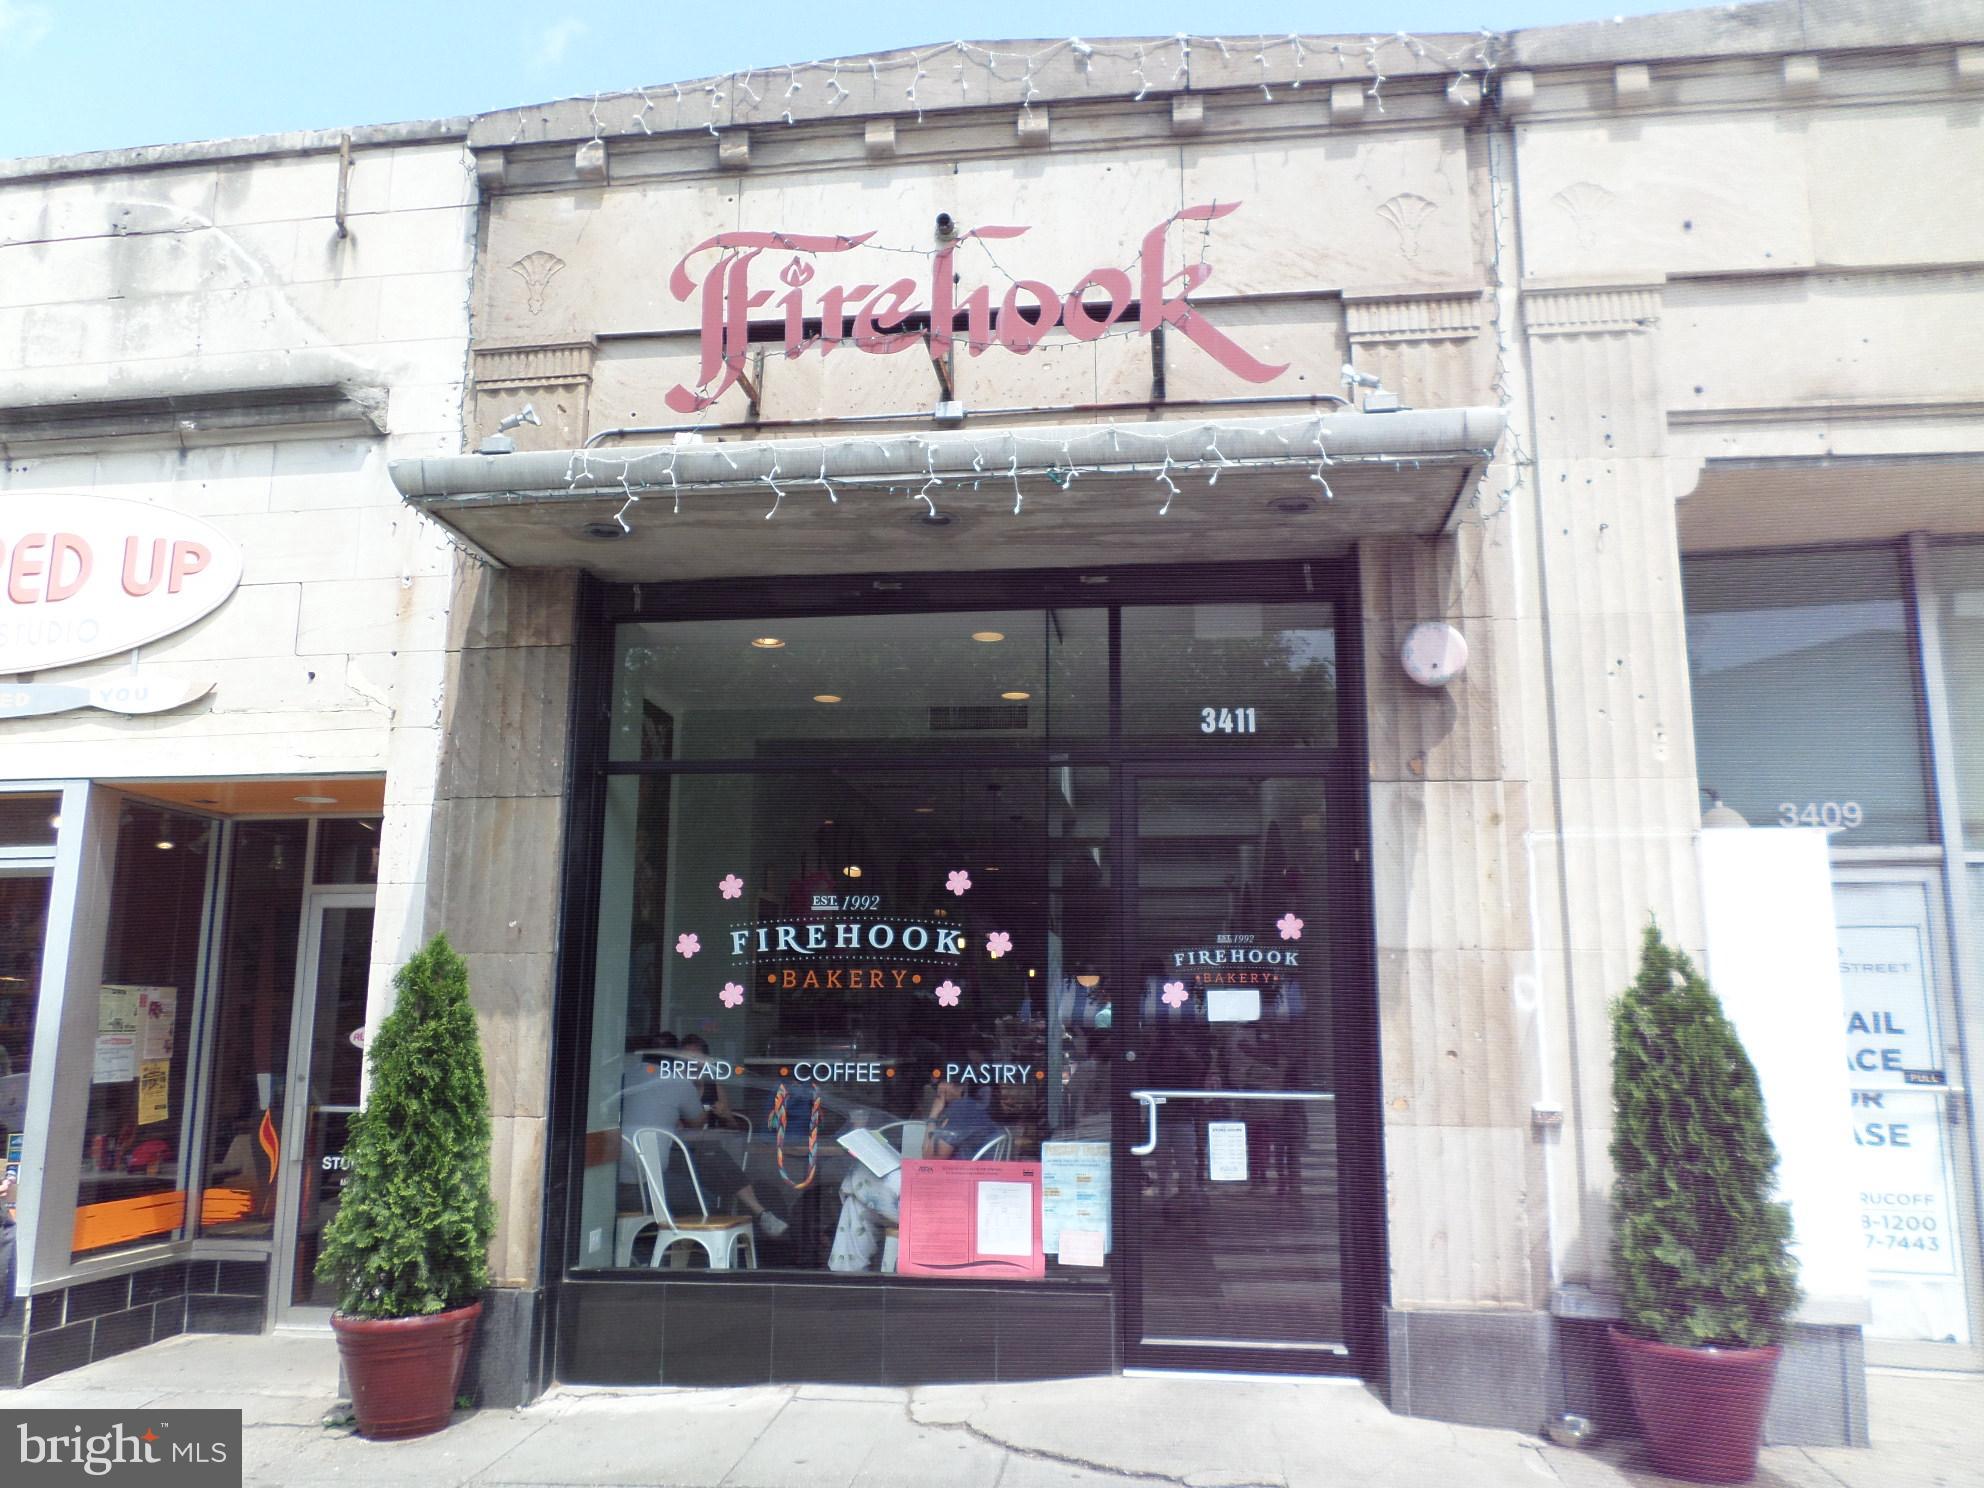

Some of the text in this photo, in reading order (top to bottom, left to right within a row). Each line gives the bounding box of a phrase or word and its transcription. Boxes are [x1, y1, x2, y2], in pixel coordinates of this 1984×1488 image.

[665, 201, 1290, 413] Firehook
[0, 532, 212, 604] ED UP
[98, 687, 149, 703] YOU
[1201, 707, 1256, 733] 3411
[1778, 802, 1863, 827] 3409
[811, 895, 880, 911] EST. 1992
[730, 923, 961, 955] FIREHOOK
[1174, 948, 1299, 966] FIREHOOK
[1203, 973, 1271, 984] BAKERY
[1838, 962, 1912, 974] STREET
[782, 969, 908, 989] BAKERY
[1846, 1011, 1905, 1034] AIL
[659, 1061, 1031, 1084] BREAD COFFEE PASTRY
[322, 1156, 353, 1170] STU
